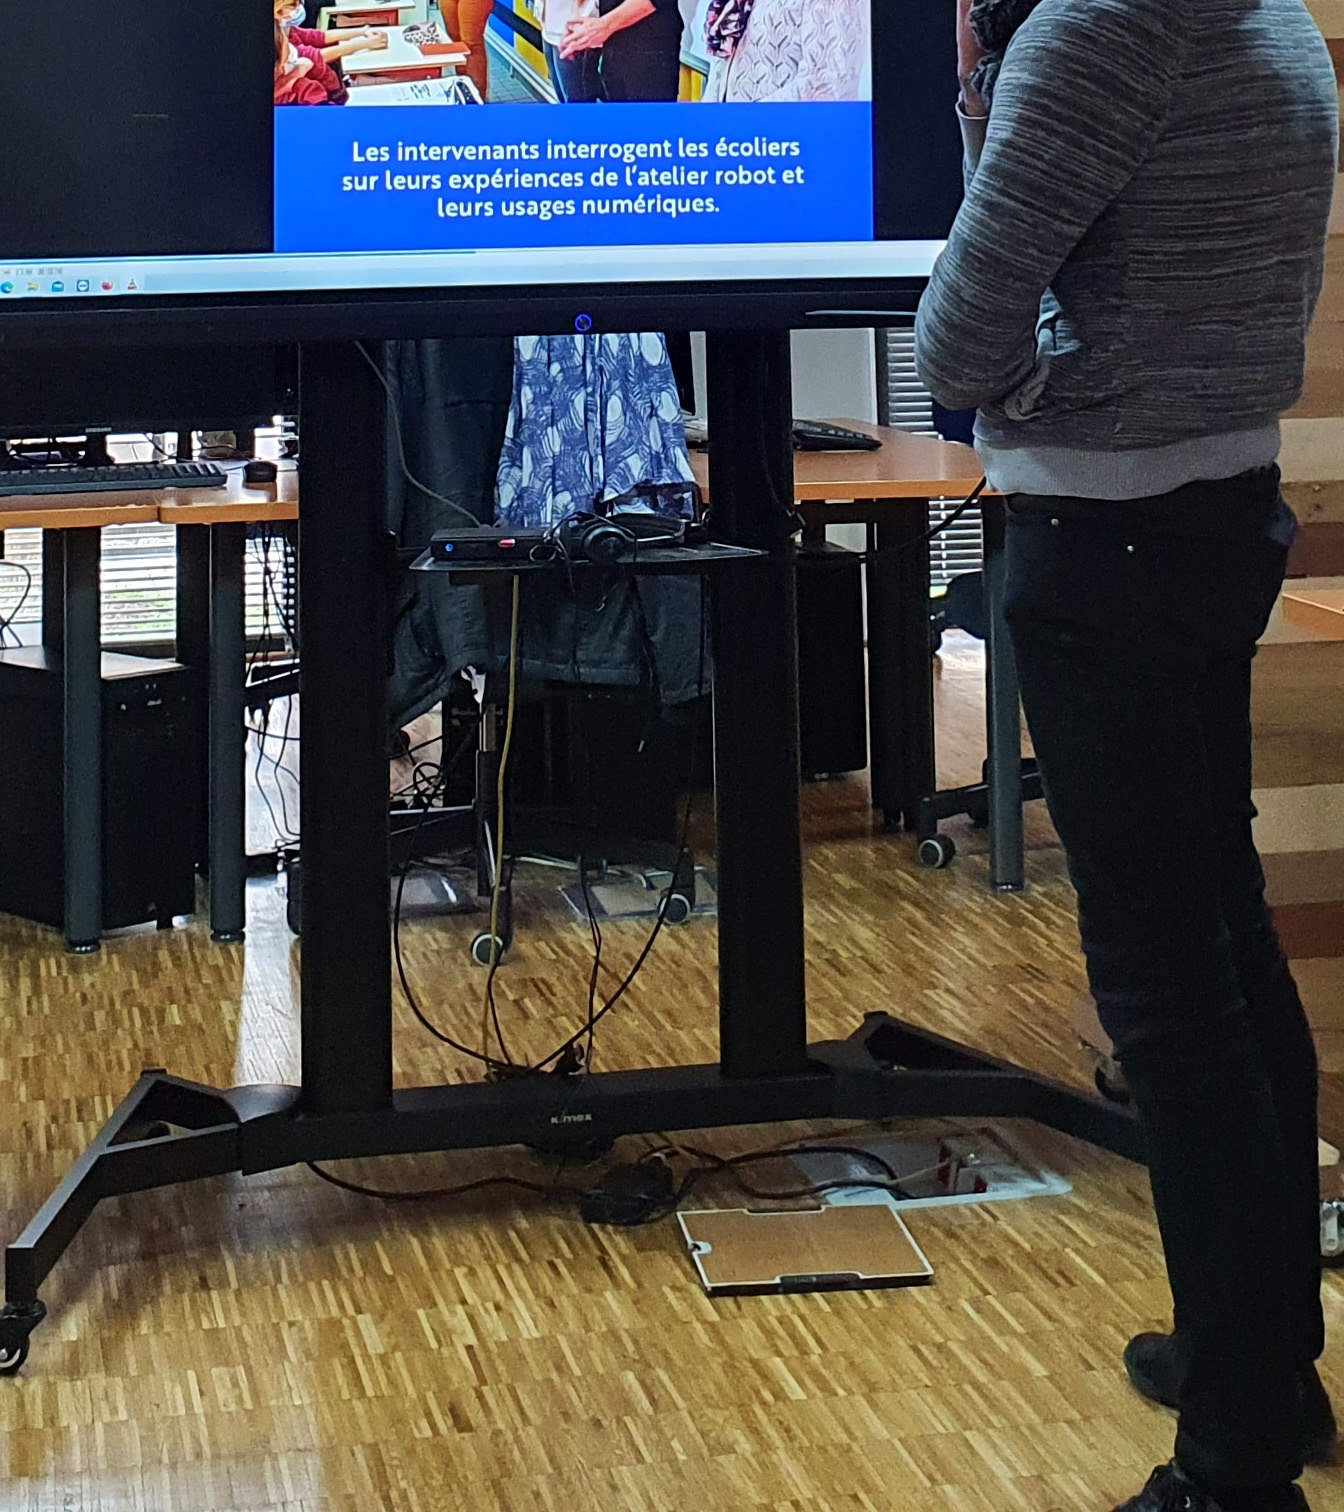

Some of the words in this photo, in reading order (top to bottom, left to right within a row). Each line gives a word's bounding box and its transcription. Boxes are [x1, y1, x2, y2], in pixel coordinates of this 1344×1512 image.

[353, 141, 390, 162] Les
[397, 141, 540, 162] intervenants
[547, 139, 672, 163] interrogent
[678, 137, 709, 158] les
[715, 137, 801, 158] écoliers
[342, 175, 379, 191] sur
[385, 169, 442, 190] leurs
[448, 168, 584, 194] expériences
[590, 166, 618, 187] de
[625, 165, 708, 186] l'atelier
[715, 165, 776, 186] robot
[782, 165, 805, 184] et
[437, 197, 494, 218] leurs
[501, 198, 575, 221] usages
[582, 193, 720, 219] numériques.
[550, 1114, 592, 1124] Kmex
